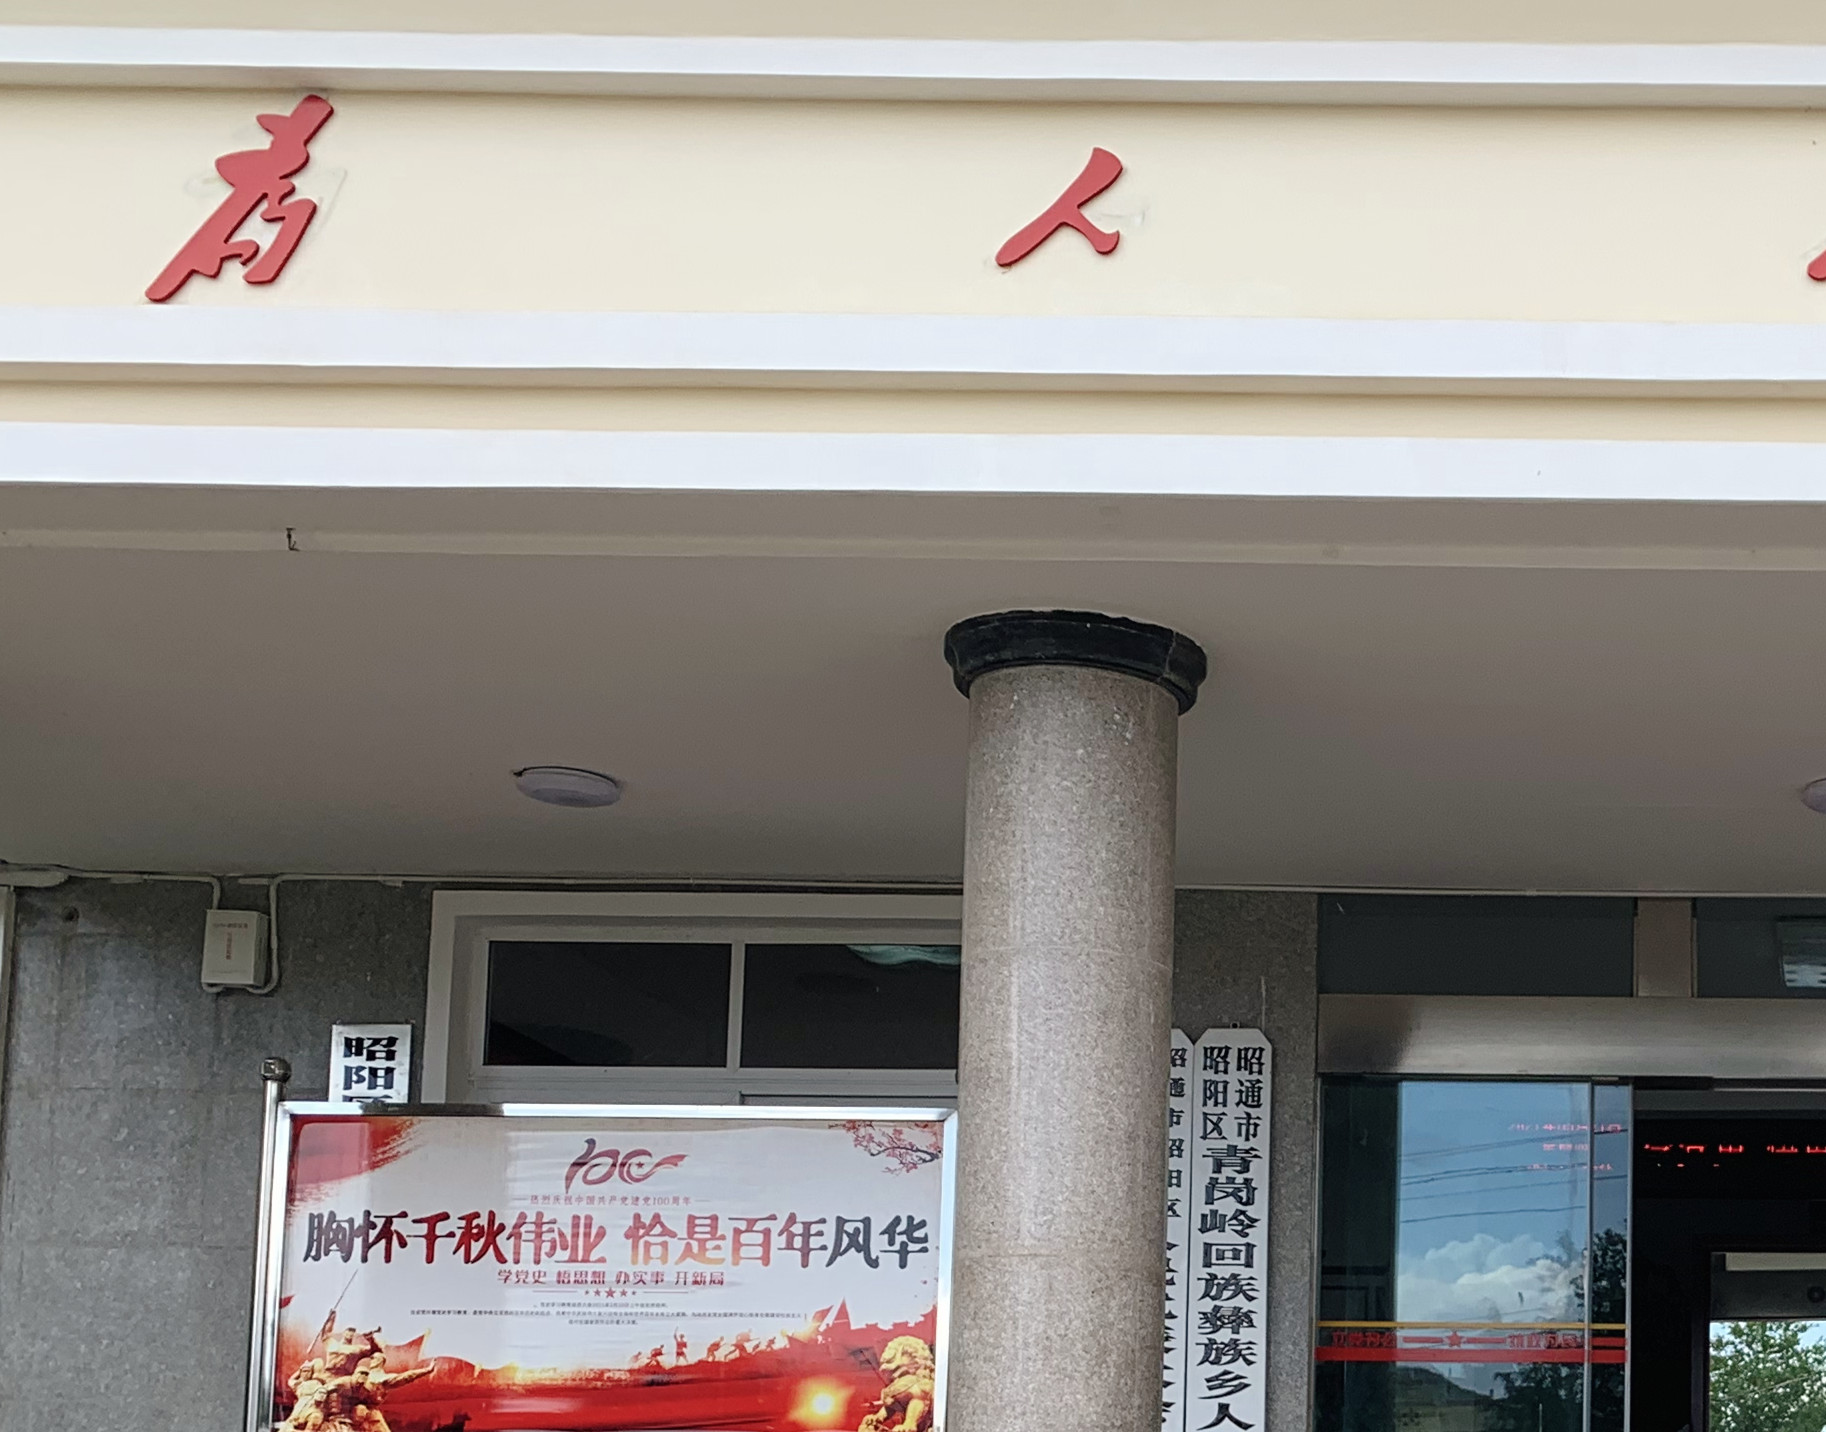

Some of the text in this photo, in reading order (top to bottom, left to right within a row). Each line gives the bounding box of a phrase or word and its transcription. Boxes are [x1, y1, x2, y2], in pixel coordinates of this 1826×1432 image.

[1200, 1045, 1232, 1141] 昭阳区
[1235, 1046, 1266, 1143] 昭通市
[303, 1210, 930, 1272] 胸怀千秋伟业 恰是百年风华
[497, 1269, 724, 1286] 学党史 悟思想 办实事 开新局
